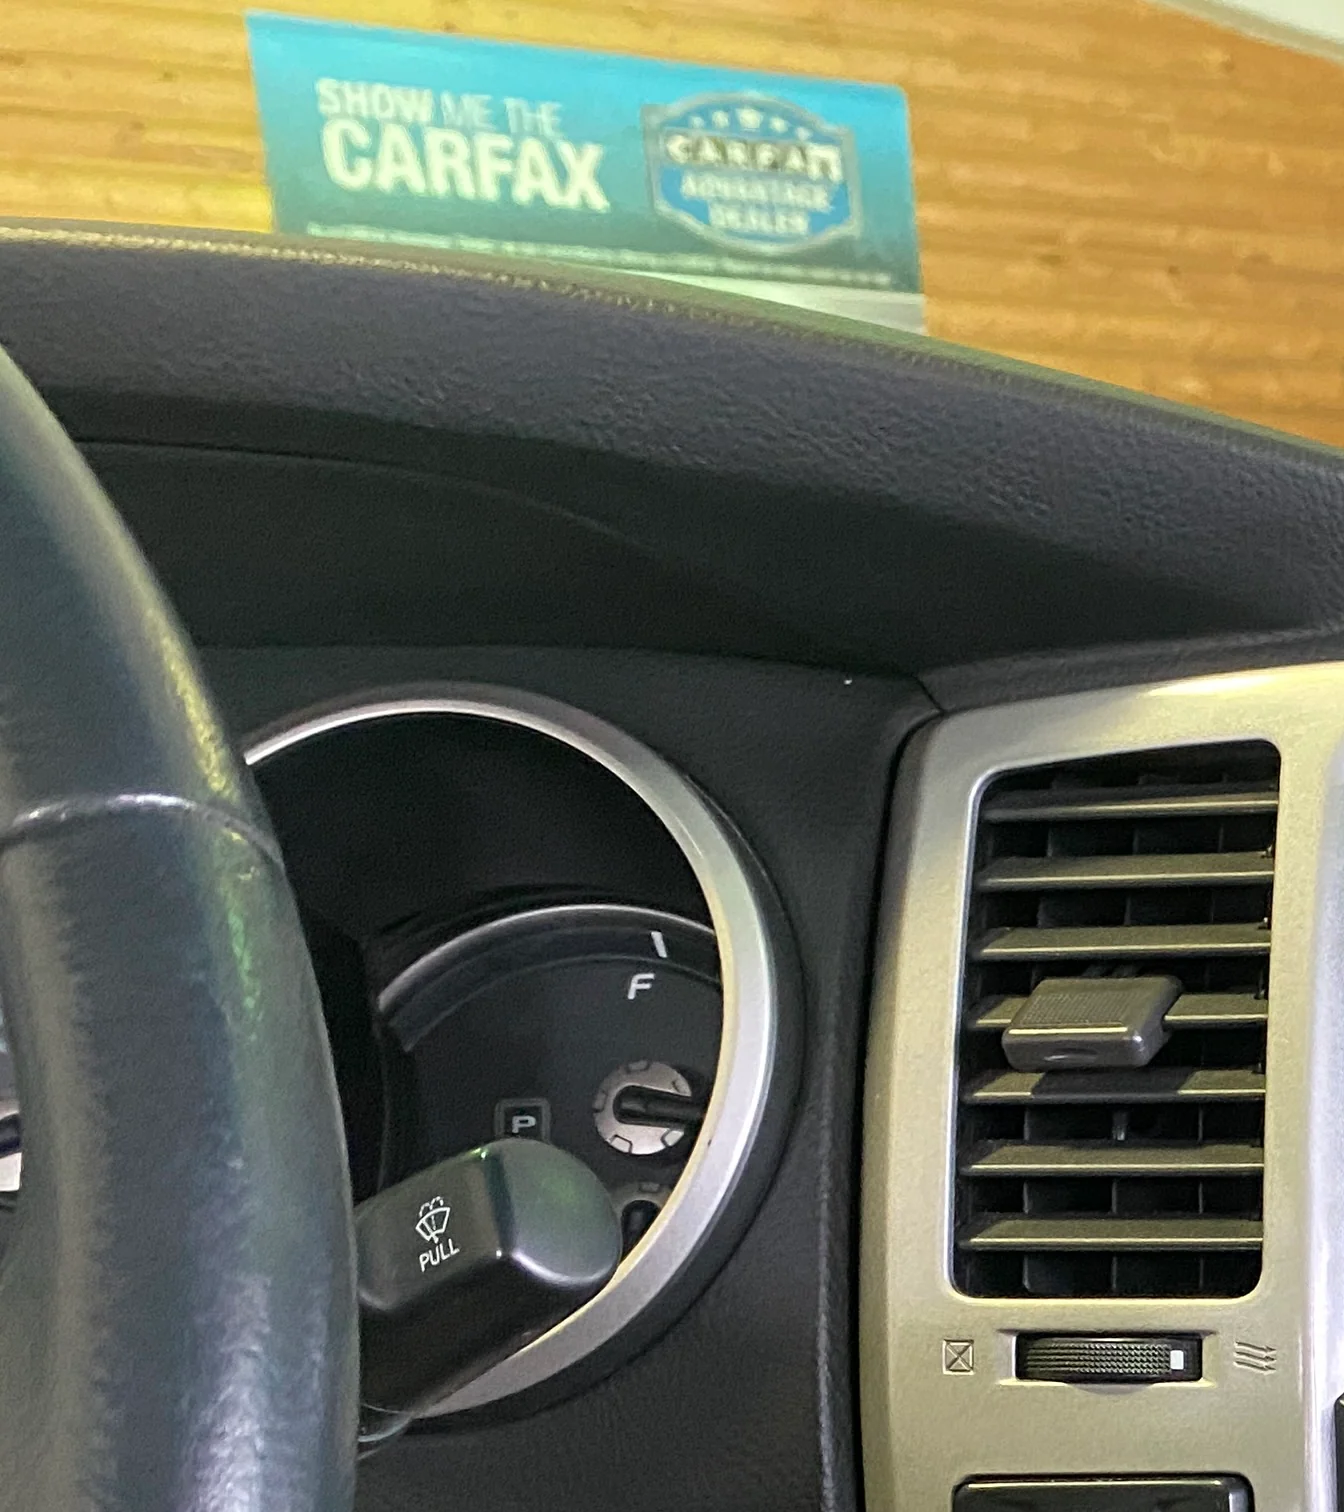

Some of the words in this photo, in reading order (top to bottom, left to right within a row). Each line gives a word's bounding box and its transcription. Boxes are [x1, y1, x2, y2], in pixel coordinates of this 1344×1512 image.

[315, 78, 433, 122] SHOW
[440, 91, 496, 130] ME
[321, 117, 611, 213] CARFAX
[627, 972, 655, 1000] F
[511, 1115, 536, 1133] P
[419, 1238, 460, 1272] PULL
